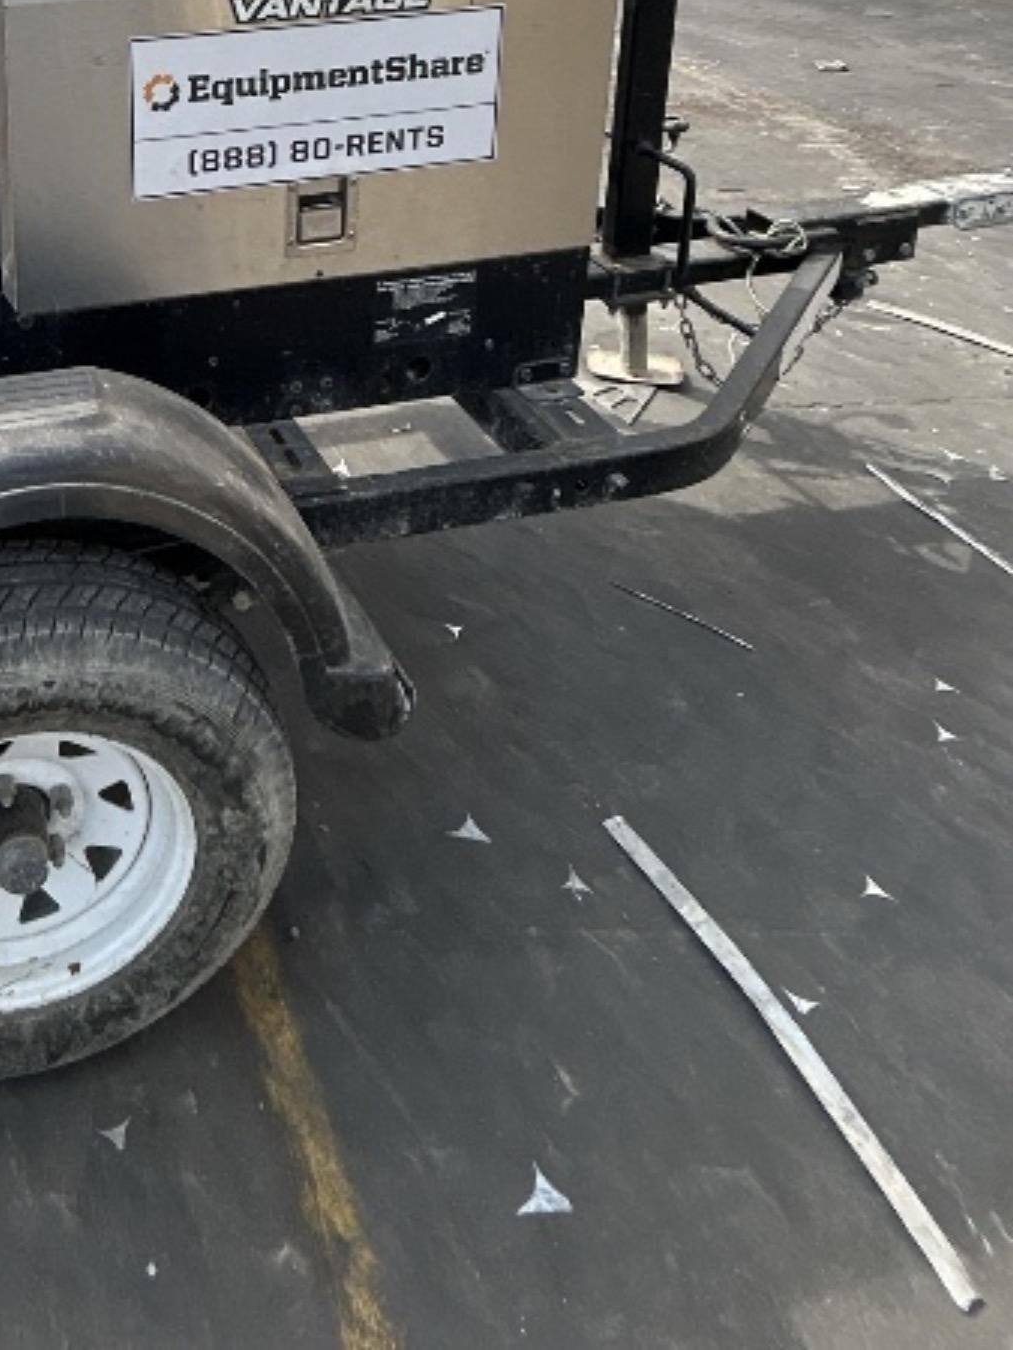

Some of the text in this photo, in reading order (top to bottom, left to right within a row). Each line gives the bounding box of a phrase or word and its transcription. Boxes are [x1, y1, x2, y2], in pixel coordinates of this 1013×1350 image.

[188, 53, 485, 105] EquipmentShare
[188, 125, 445, 175] (888) 80-RENTS
